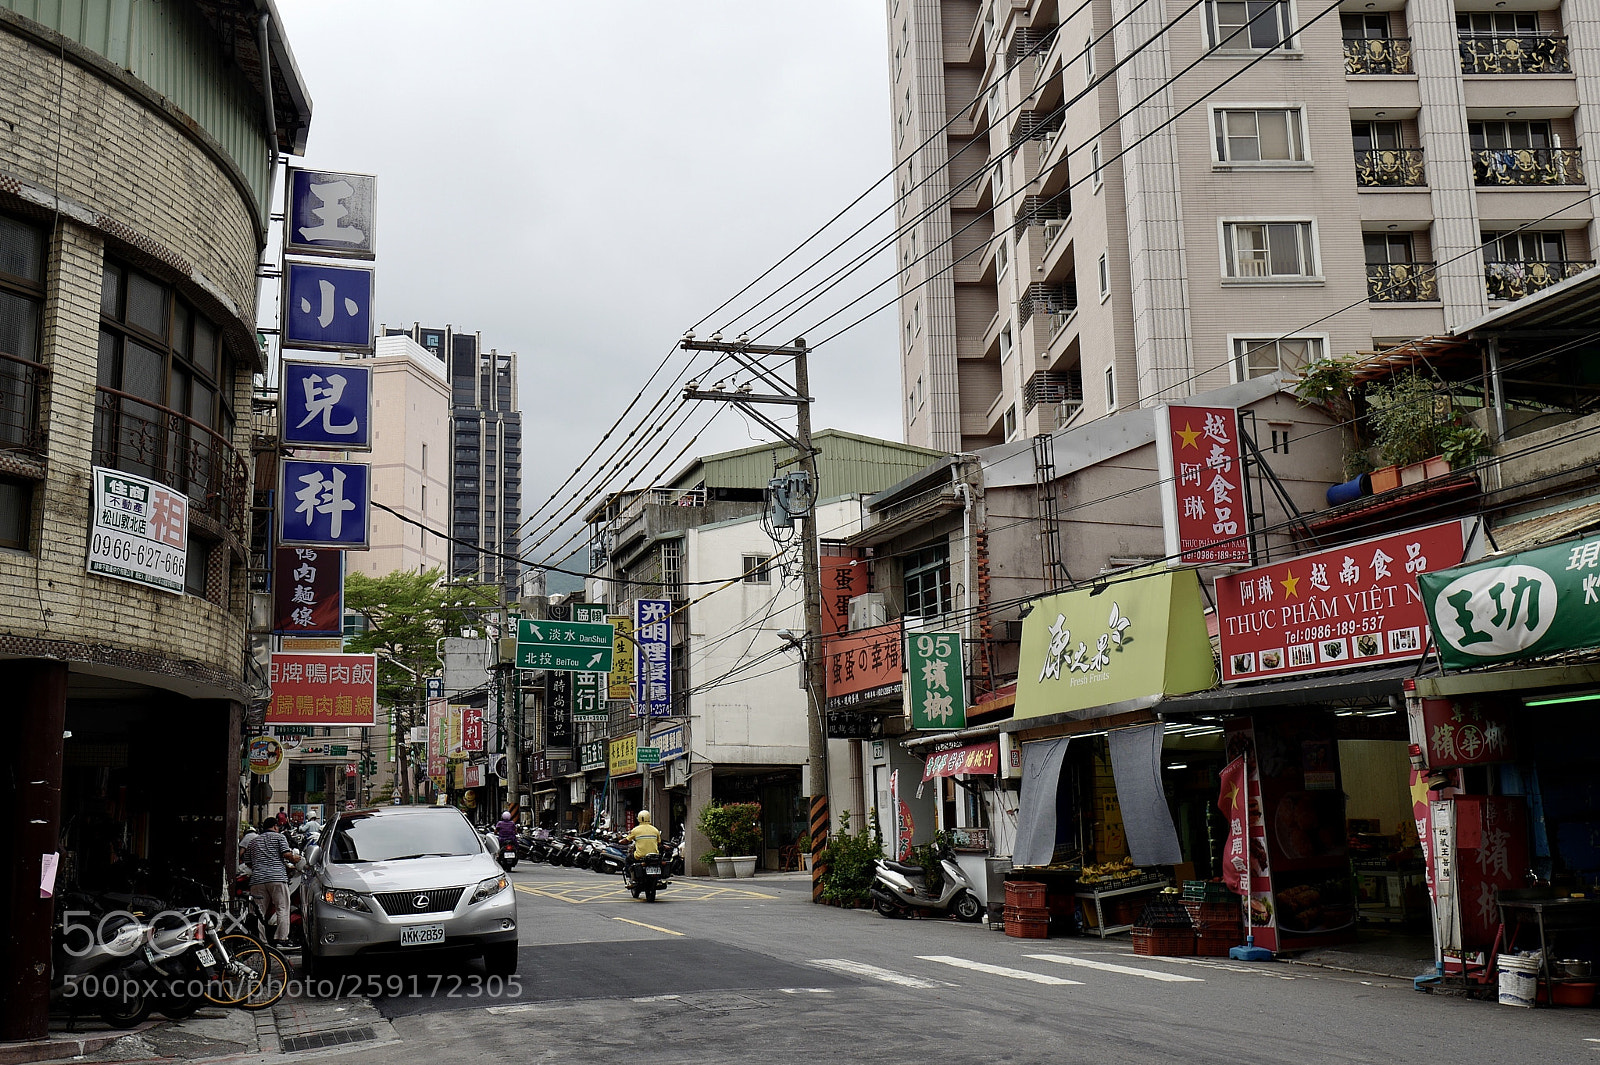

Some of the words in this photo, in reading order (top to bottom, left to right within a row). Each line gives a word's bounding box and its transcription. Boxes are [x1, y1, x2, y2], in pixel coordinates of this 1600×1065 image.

[295, 179, 365, 538] 王小兒科
[1203, 412, 1238, 535] 越南食品
[109, 496, 143, 513] 不動產
[1180, 463, 1206, 520] 阿琳
[102, 509, 147, 535] 松山敦北店
[150, 490, 185, 549] 租
[93, 533, 185, 577] 0966-627-666
[1240, 575, 1274, 606] 阿琳
[1309, 542, 1427, 592] 越南食品
[1344, 584, 1398, 616] VIỆT
[549, 628, 576, 642] 淡水
[579, 633, 607, 644] DanShui
[1285, 615, 1385, 645] Tel:0986-189-537
[525, 652, 552, 665] 北投
[555, 658, 579, 667] BeiTou
[832, 637, 899, 684] 蛋蛋の幸福
[917, 635, 952, 658] 95
[921, 659, 953, 725] 檳榔
[1070, 674, 1088, 687] Fresh
[1089, 671, 1110, 684] Fruits
[266, 694, 372, 717] 歸鴨肉麵線
[638, 703, 670, 715] 281-2374
[402, 928, 444, 944] AKK-2839
